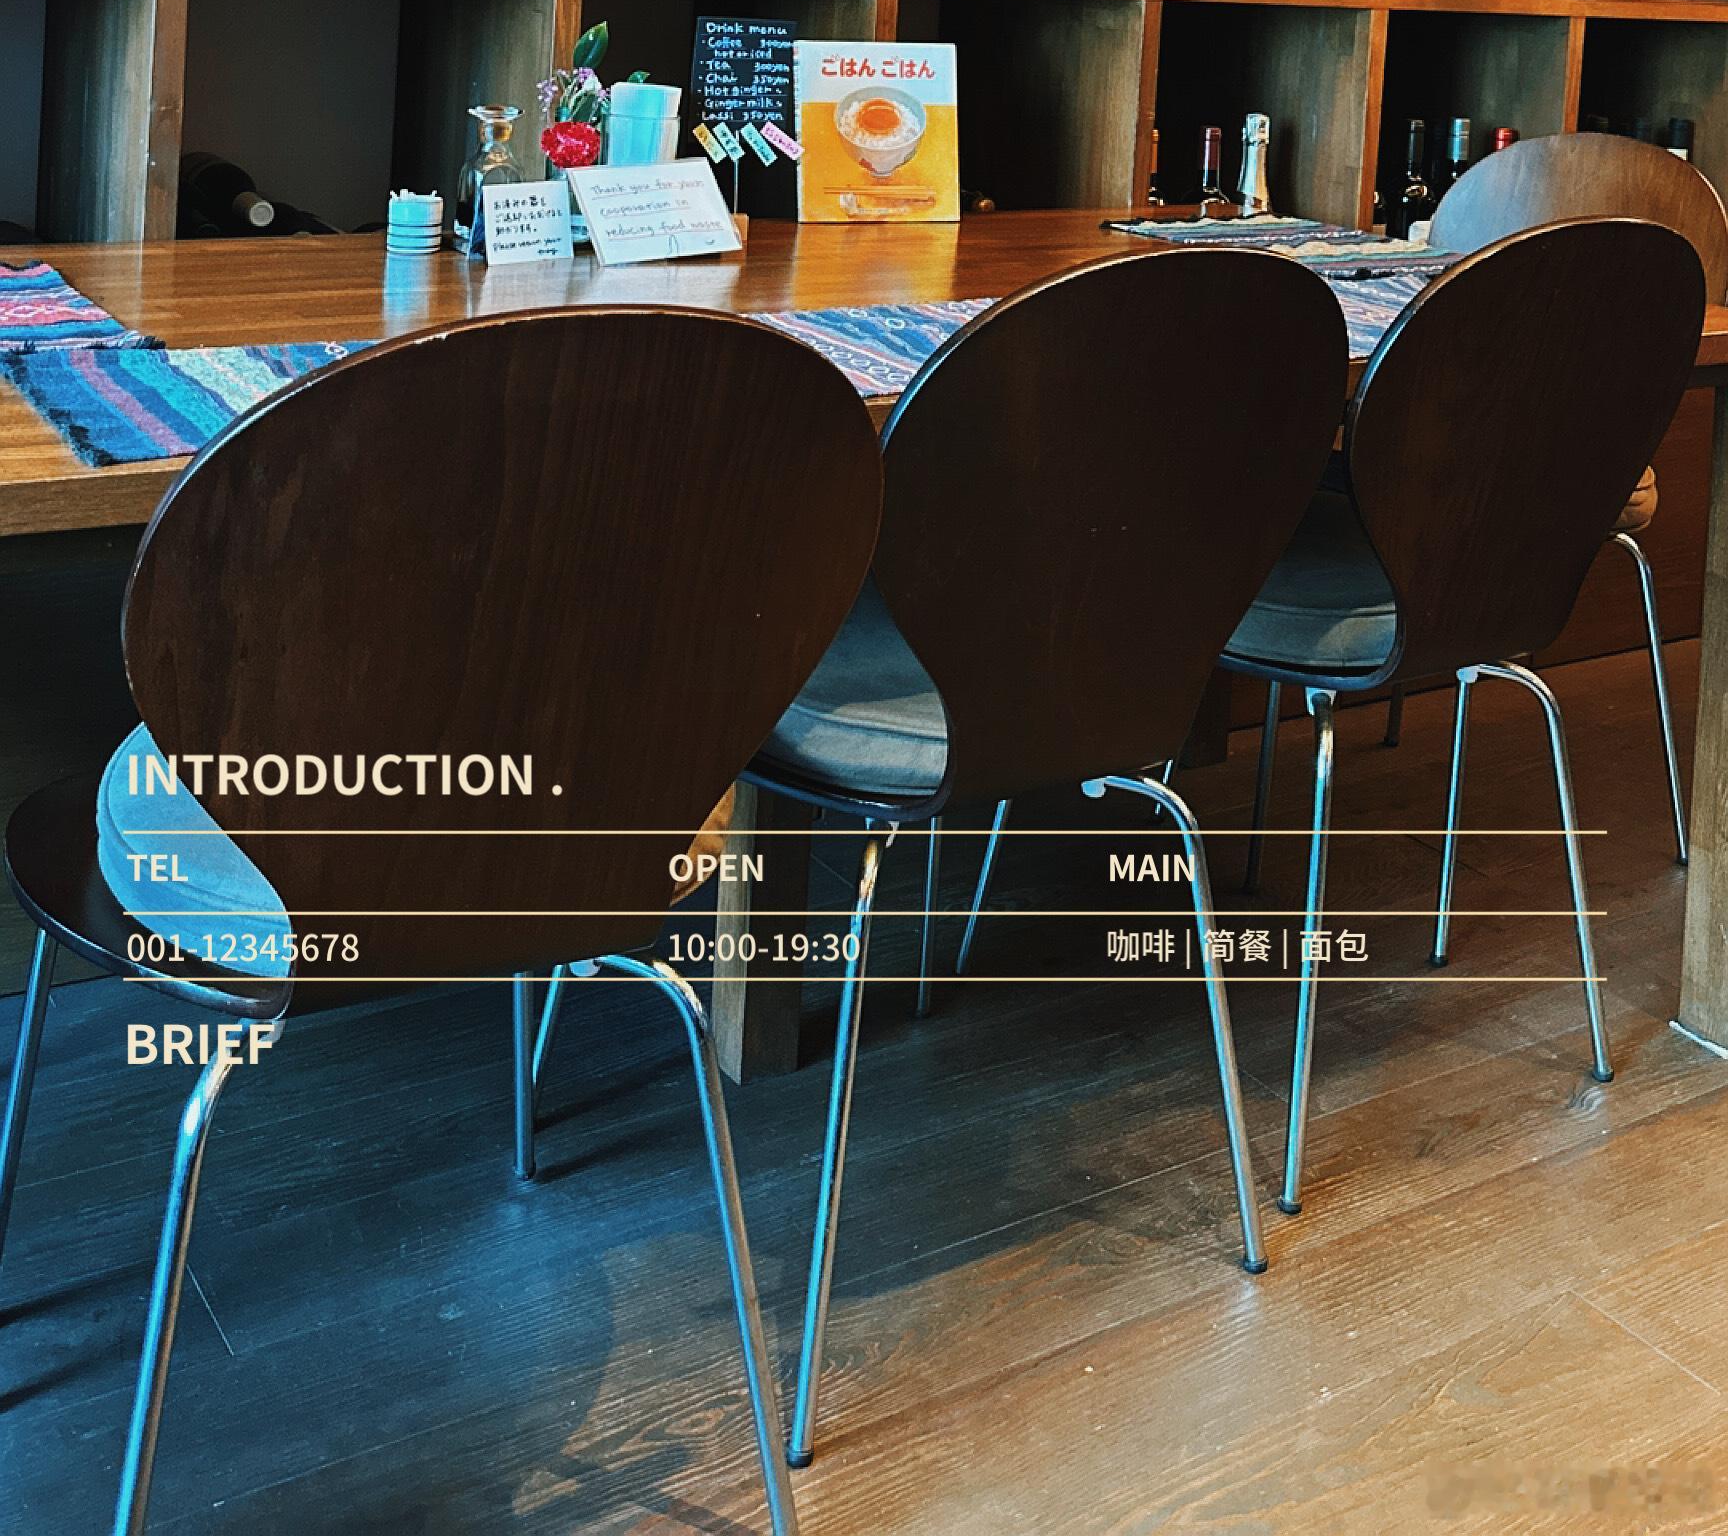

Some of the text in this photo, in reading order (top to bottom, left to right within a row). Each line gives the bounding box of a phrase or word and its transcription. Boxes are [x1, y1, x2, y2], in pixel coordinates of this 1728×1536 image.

[706, 22, 788, 35] Drink menu
[822, 54, 936, 79] ごはん ごはん
[592, 183, 625, 196] Thank
